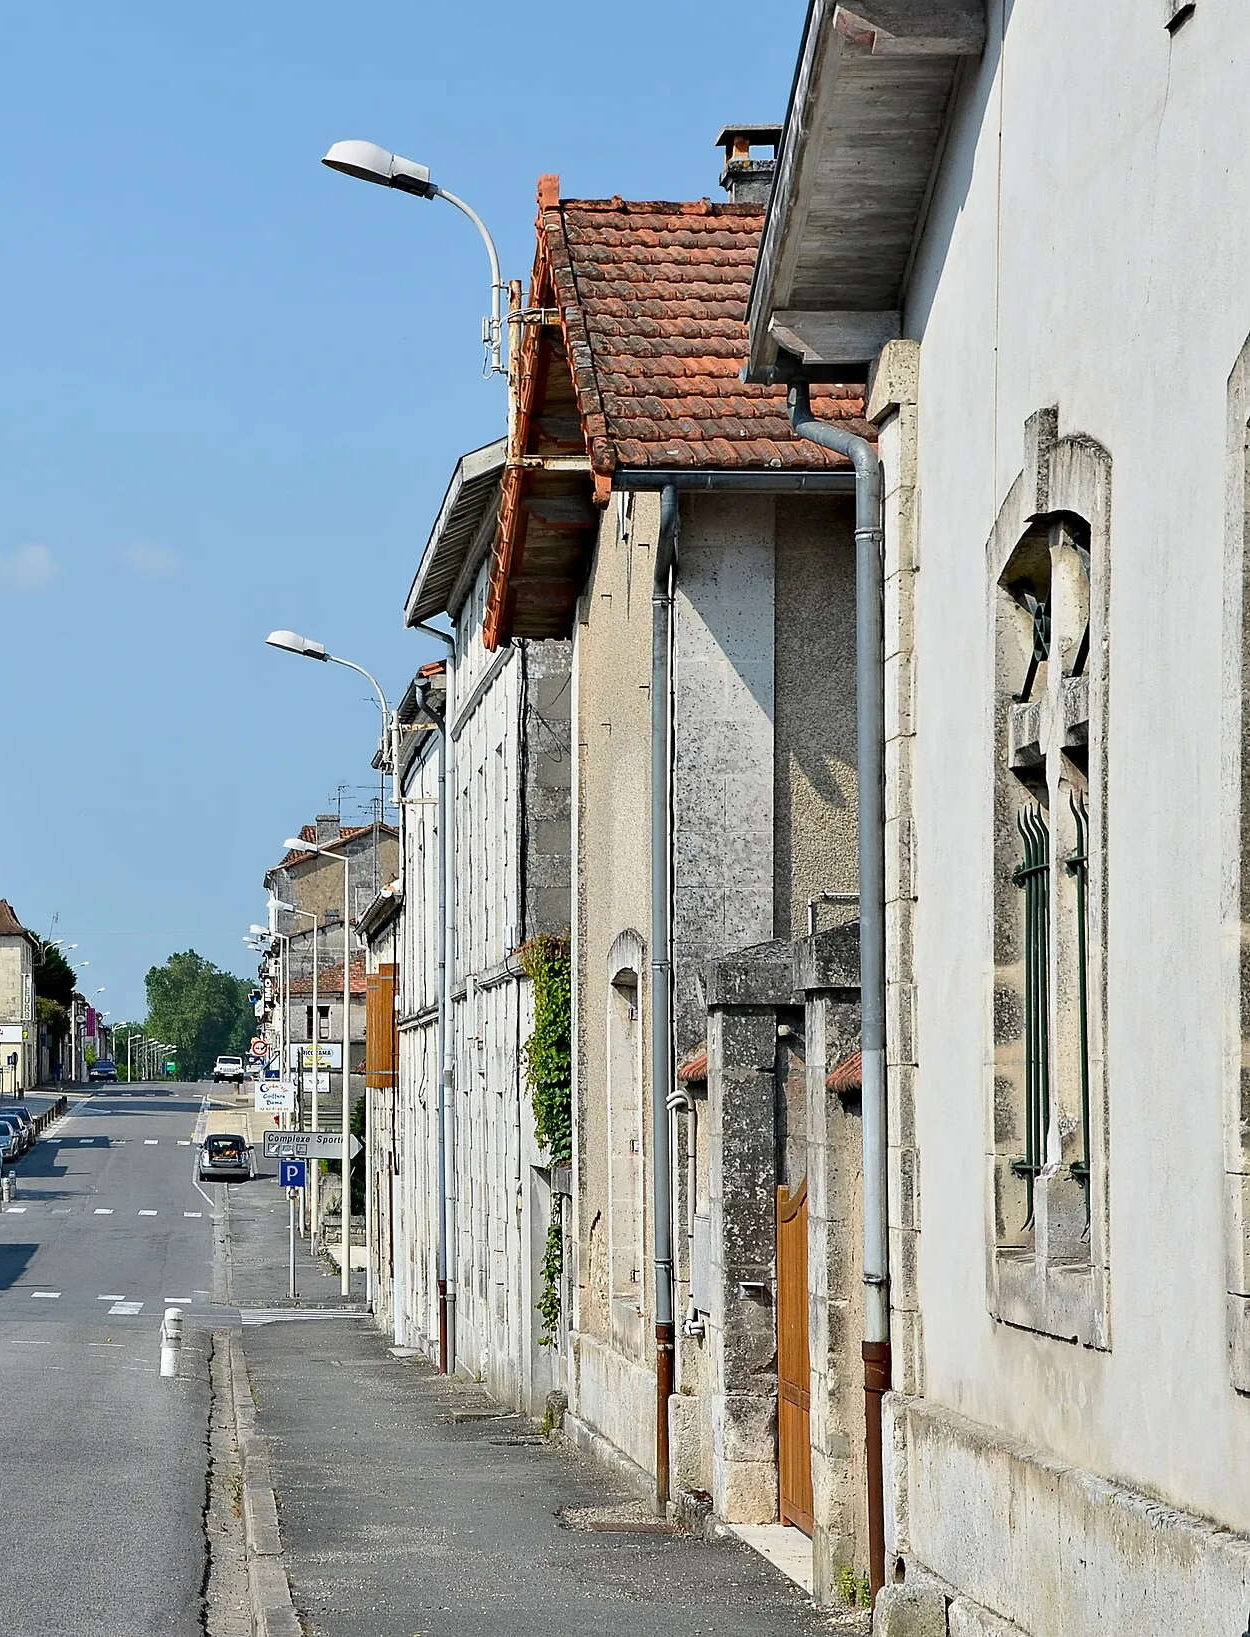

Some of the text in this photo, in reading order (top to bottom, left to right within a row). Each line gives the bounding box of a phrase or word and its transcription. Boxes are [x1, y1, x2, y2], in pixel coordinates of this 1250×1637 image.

[268, 1134, 343, 1145] Complexe Sporti
[287, 1165, 298, 1181] P
